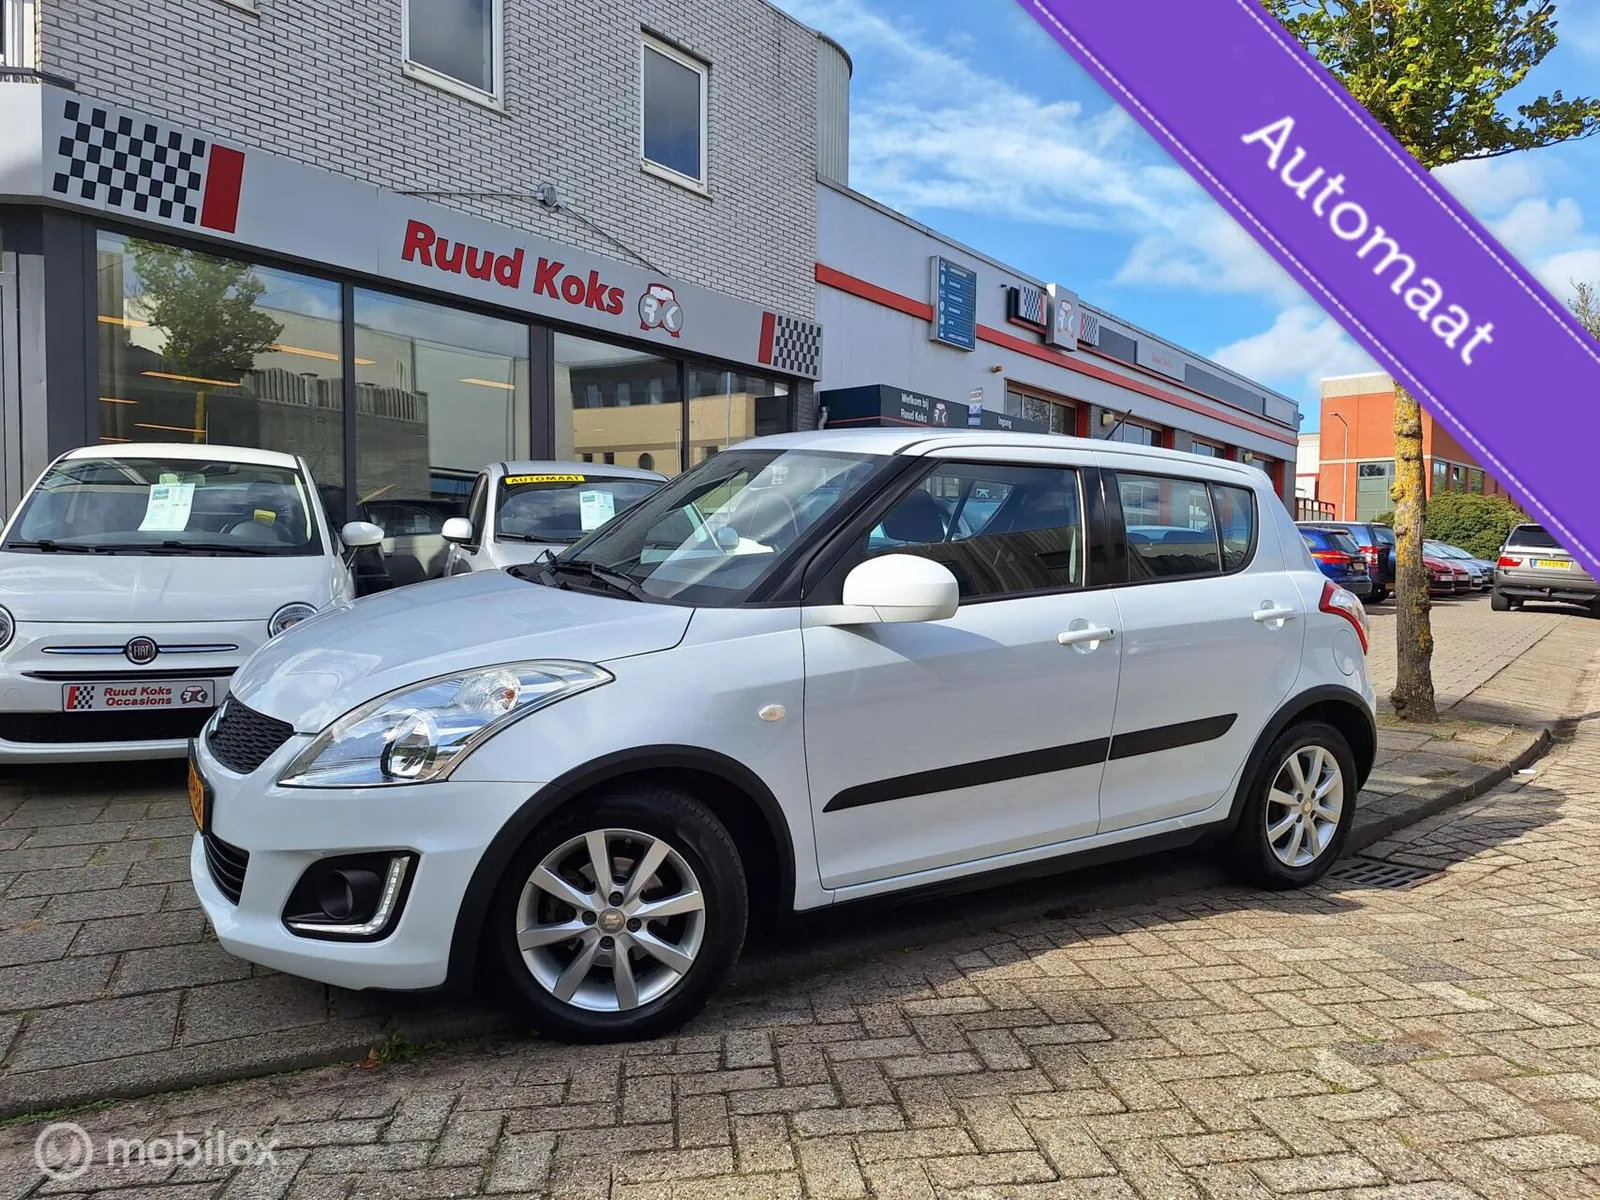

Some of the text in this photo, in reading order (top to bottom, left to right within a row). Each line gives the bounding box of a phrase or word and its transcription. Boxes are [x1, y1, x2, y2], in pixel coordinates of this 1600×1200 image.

[401, 218, 625, 315] Ruud Koks
[901, 392, 922, 407] Welkom
[900, 407, 928, 423] Ruud Koks
[133, 645, 150, 657] FIAT
[103, 686, 172, 697] Ruud Koks
[106, 696, 172, 706] Occasions
